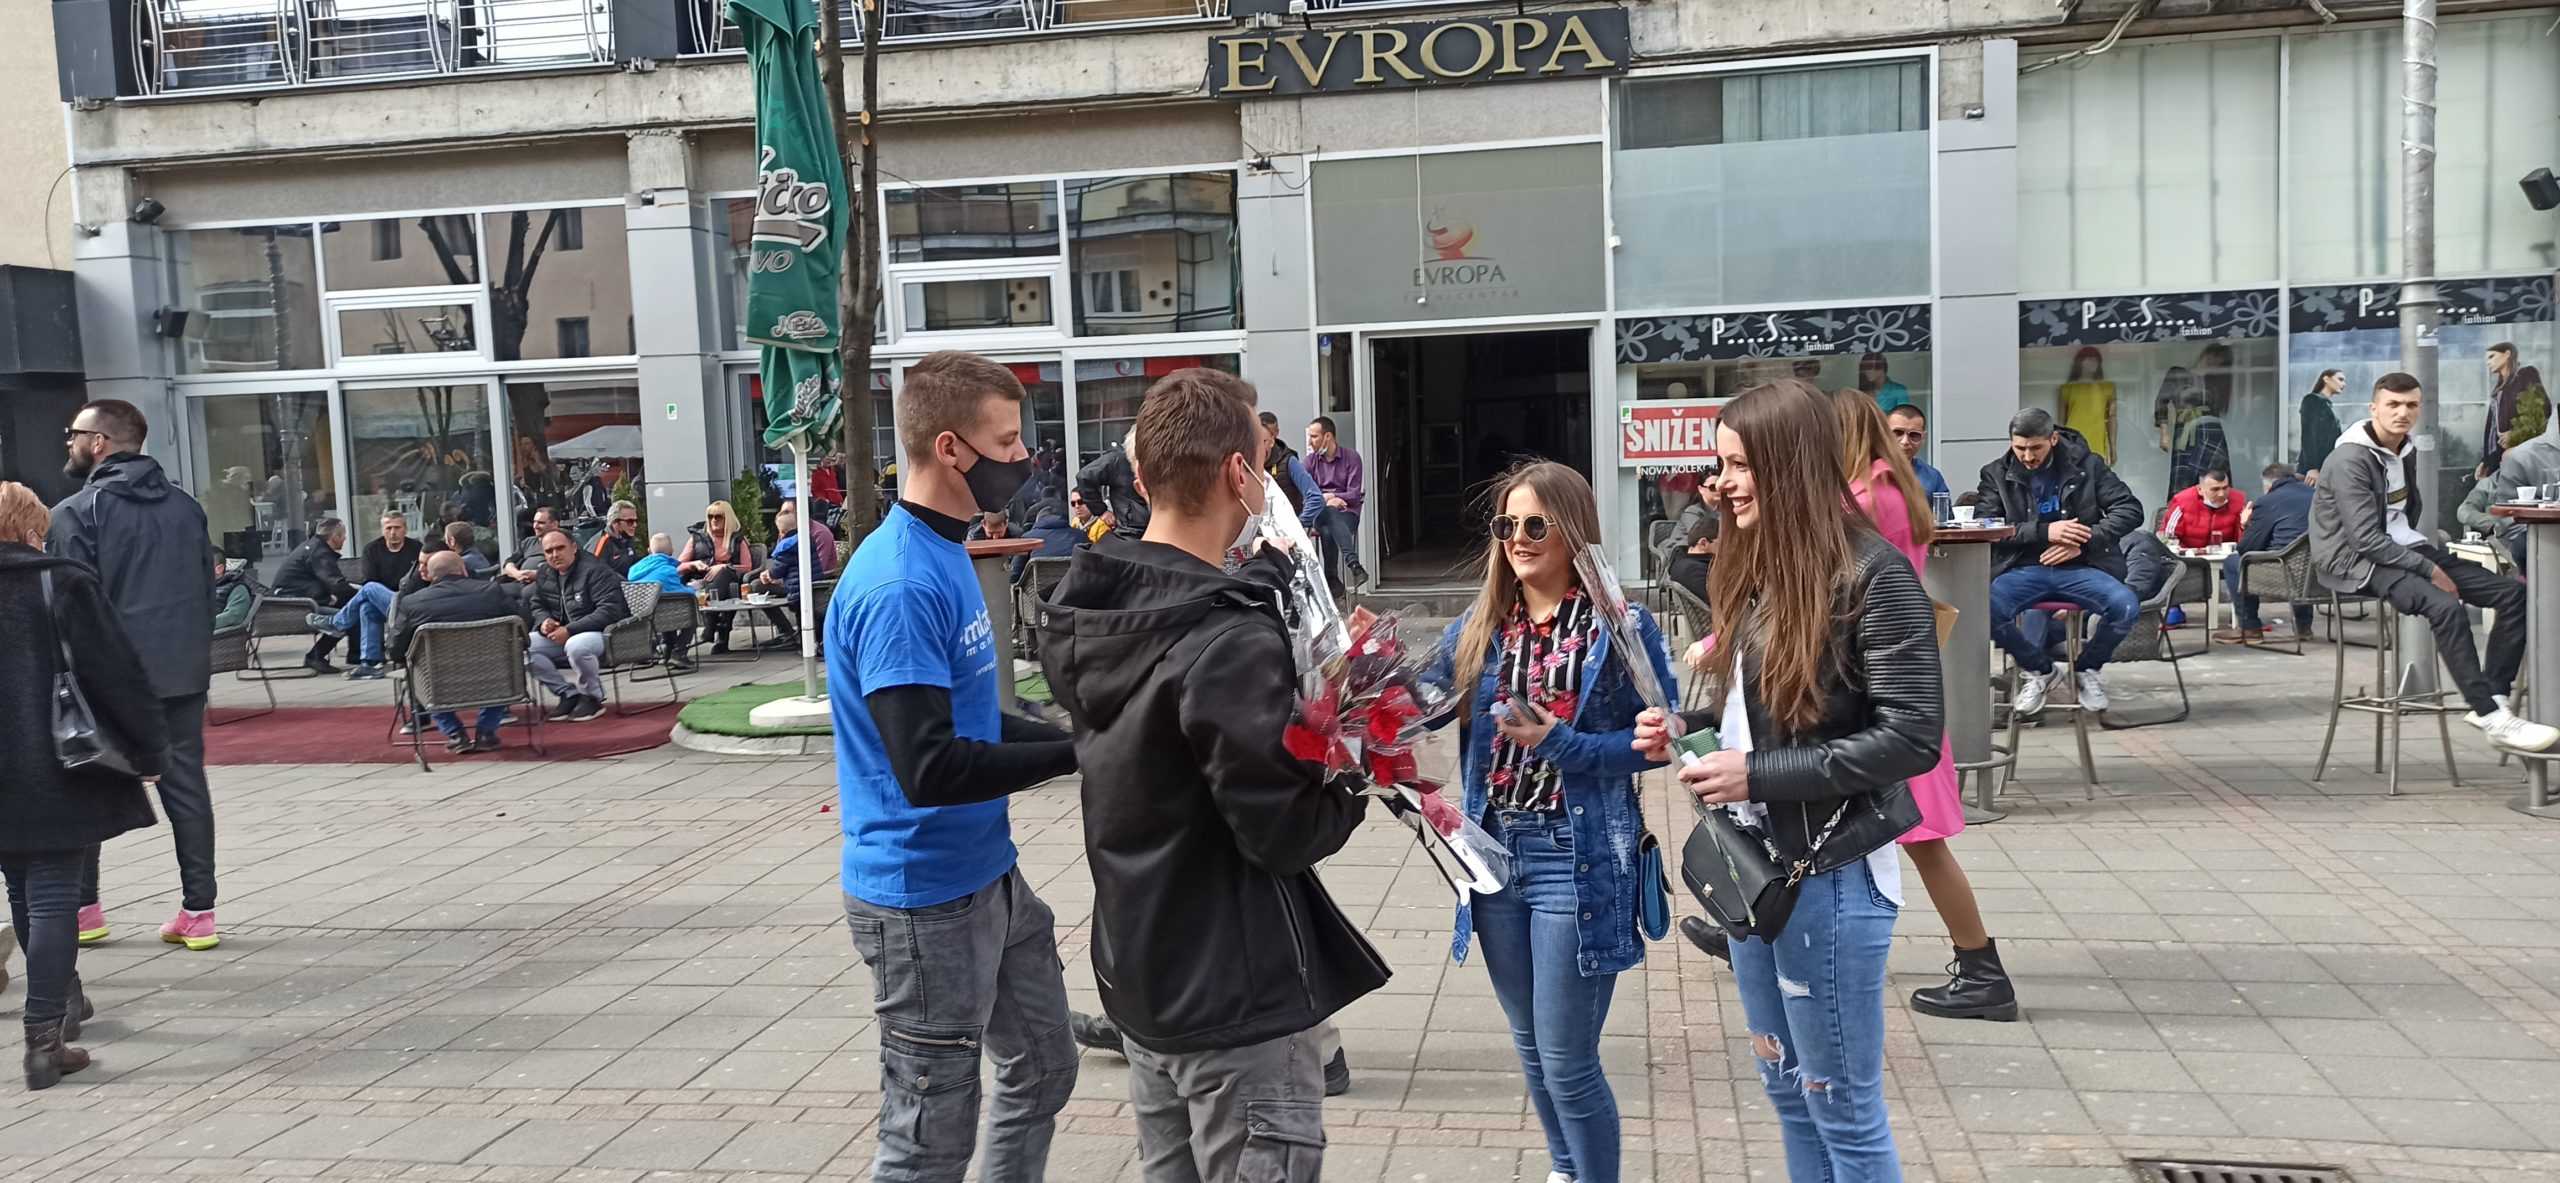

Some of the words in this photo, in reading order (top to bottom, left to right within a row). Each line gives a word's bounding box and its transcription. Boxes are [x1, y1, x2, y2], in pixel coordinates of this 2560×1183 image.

[1218, 15, 1616, 93] EVROPA
[1413, 264, 1507, 287] EVROPA
[1641, 465, 1670, 476] NOVA
